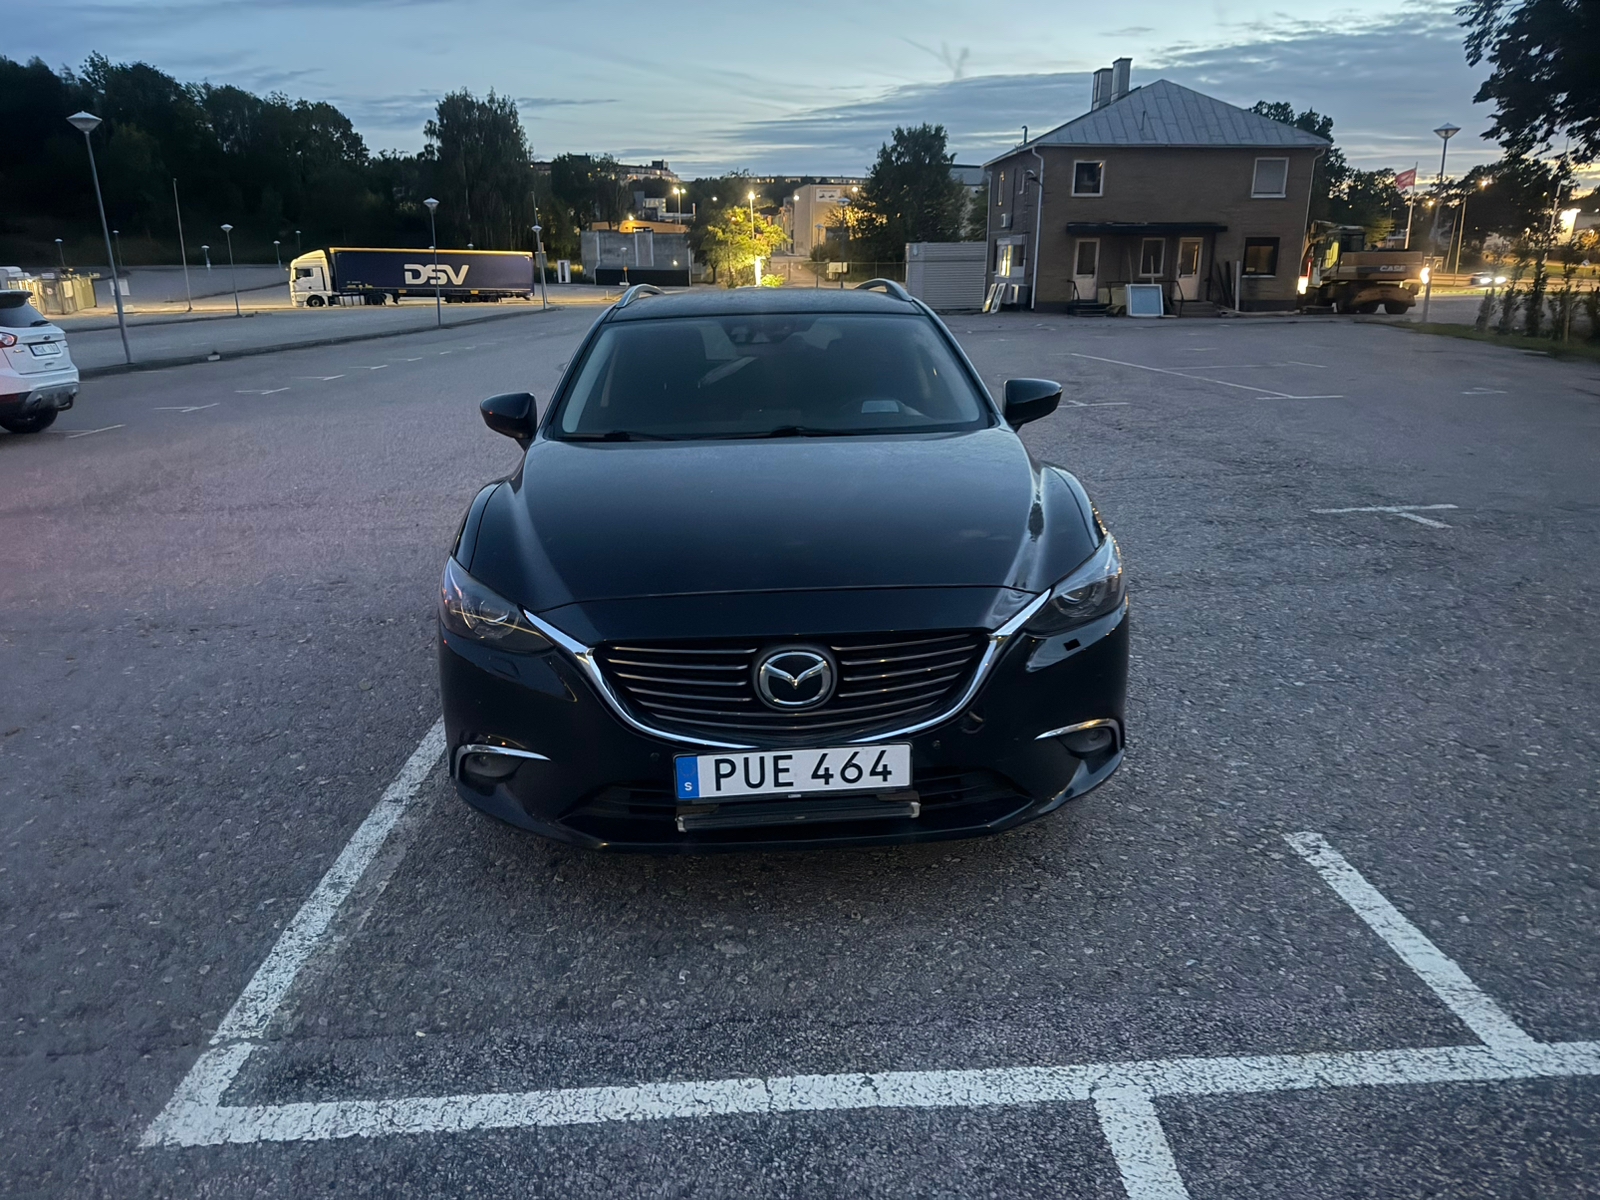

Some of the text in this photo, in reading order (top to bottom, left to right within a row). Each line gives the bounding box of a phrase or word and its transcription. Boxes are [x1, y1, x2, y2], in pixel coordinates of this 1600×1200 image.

[404, 264, 469, 285] DSV
[714, 750, 892, 791] PUE 464
[684, 782, 693, 791] S
